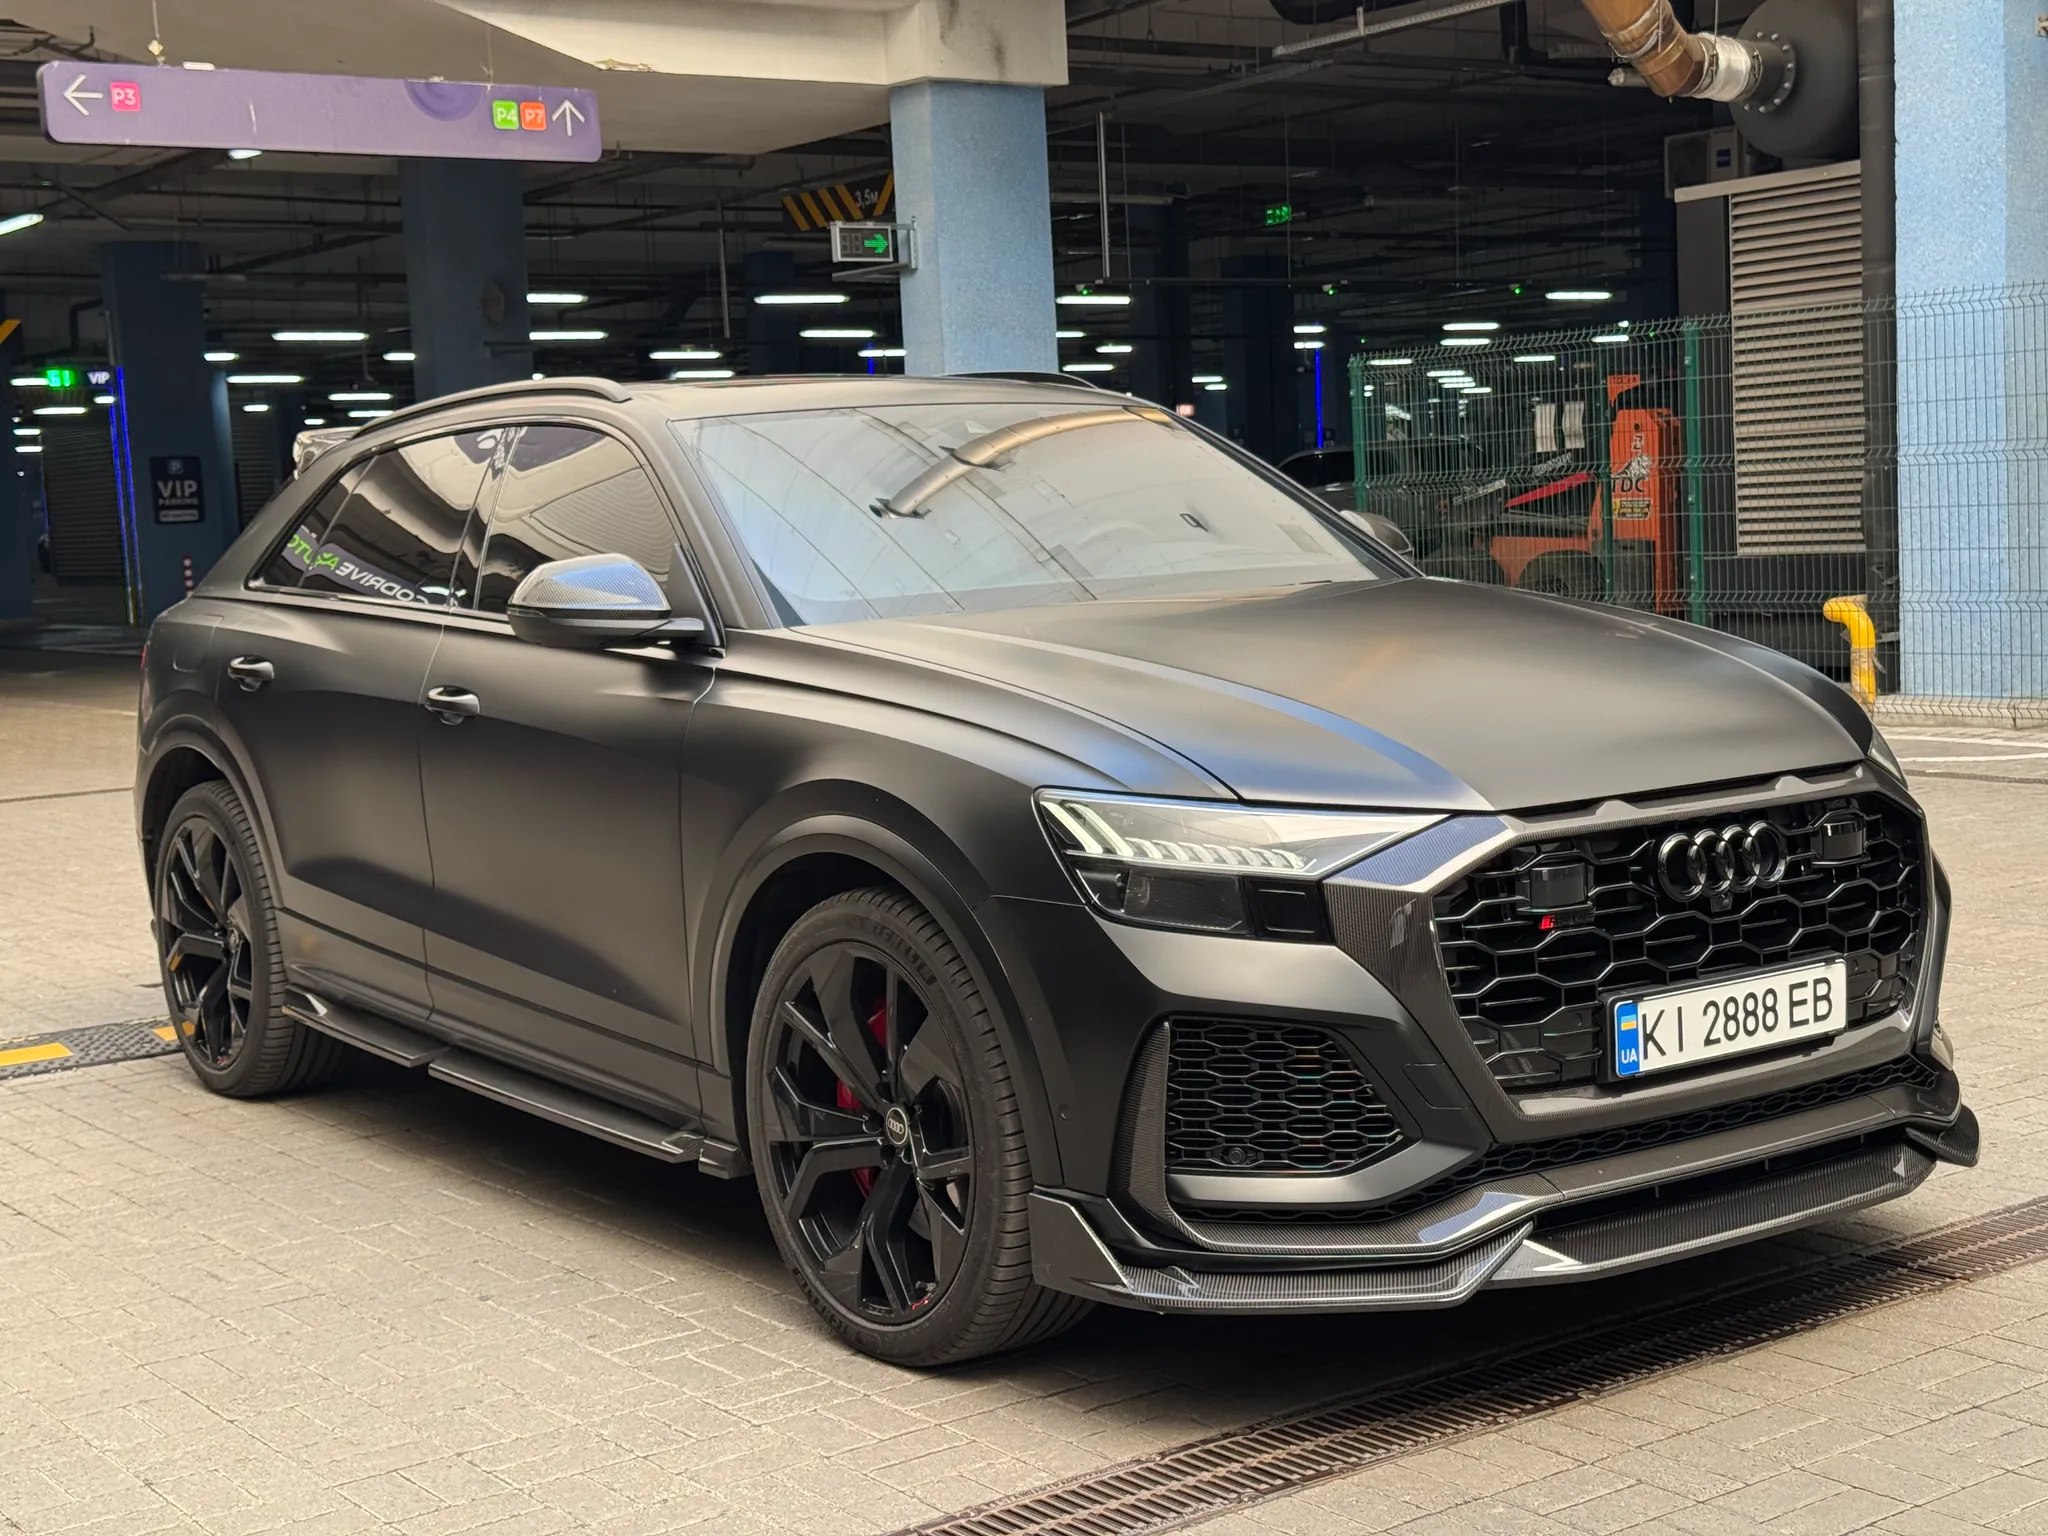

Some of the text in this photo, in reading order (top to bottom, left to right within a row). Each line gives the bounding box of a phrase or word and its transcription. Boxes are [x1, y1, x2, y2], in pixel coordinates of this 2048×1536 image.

[112, 87, 137, 105] P3
[496, 107, 543, 124] P4 P7
[87, 371, 110, 385] VIP
[157, 480, 198, 498] VIP
[1702, 987, 1779, 1047] 2888
[1788, 976, 1833, 1029] EB
[1621, 1048, 1638, 1064] UA
